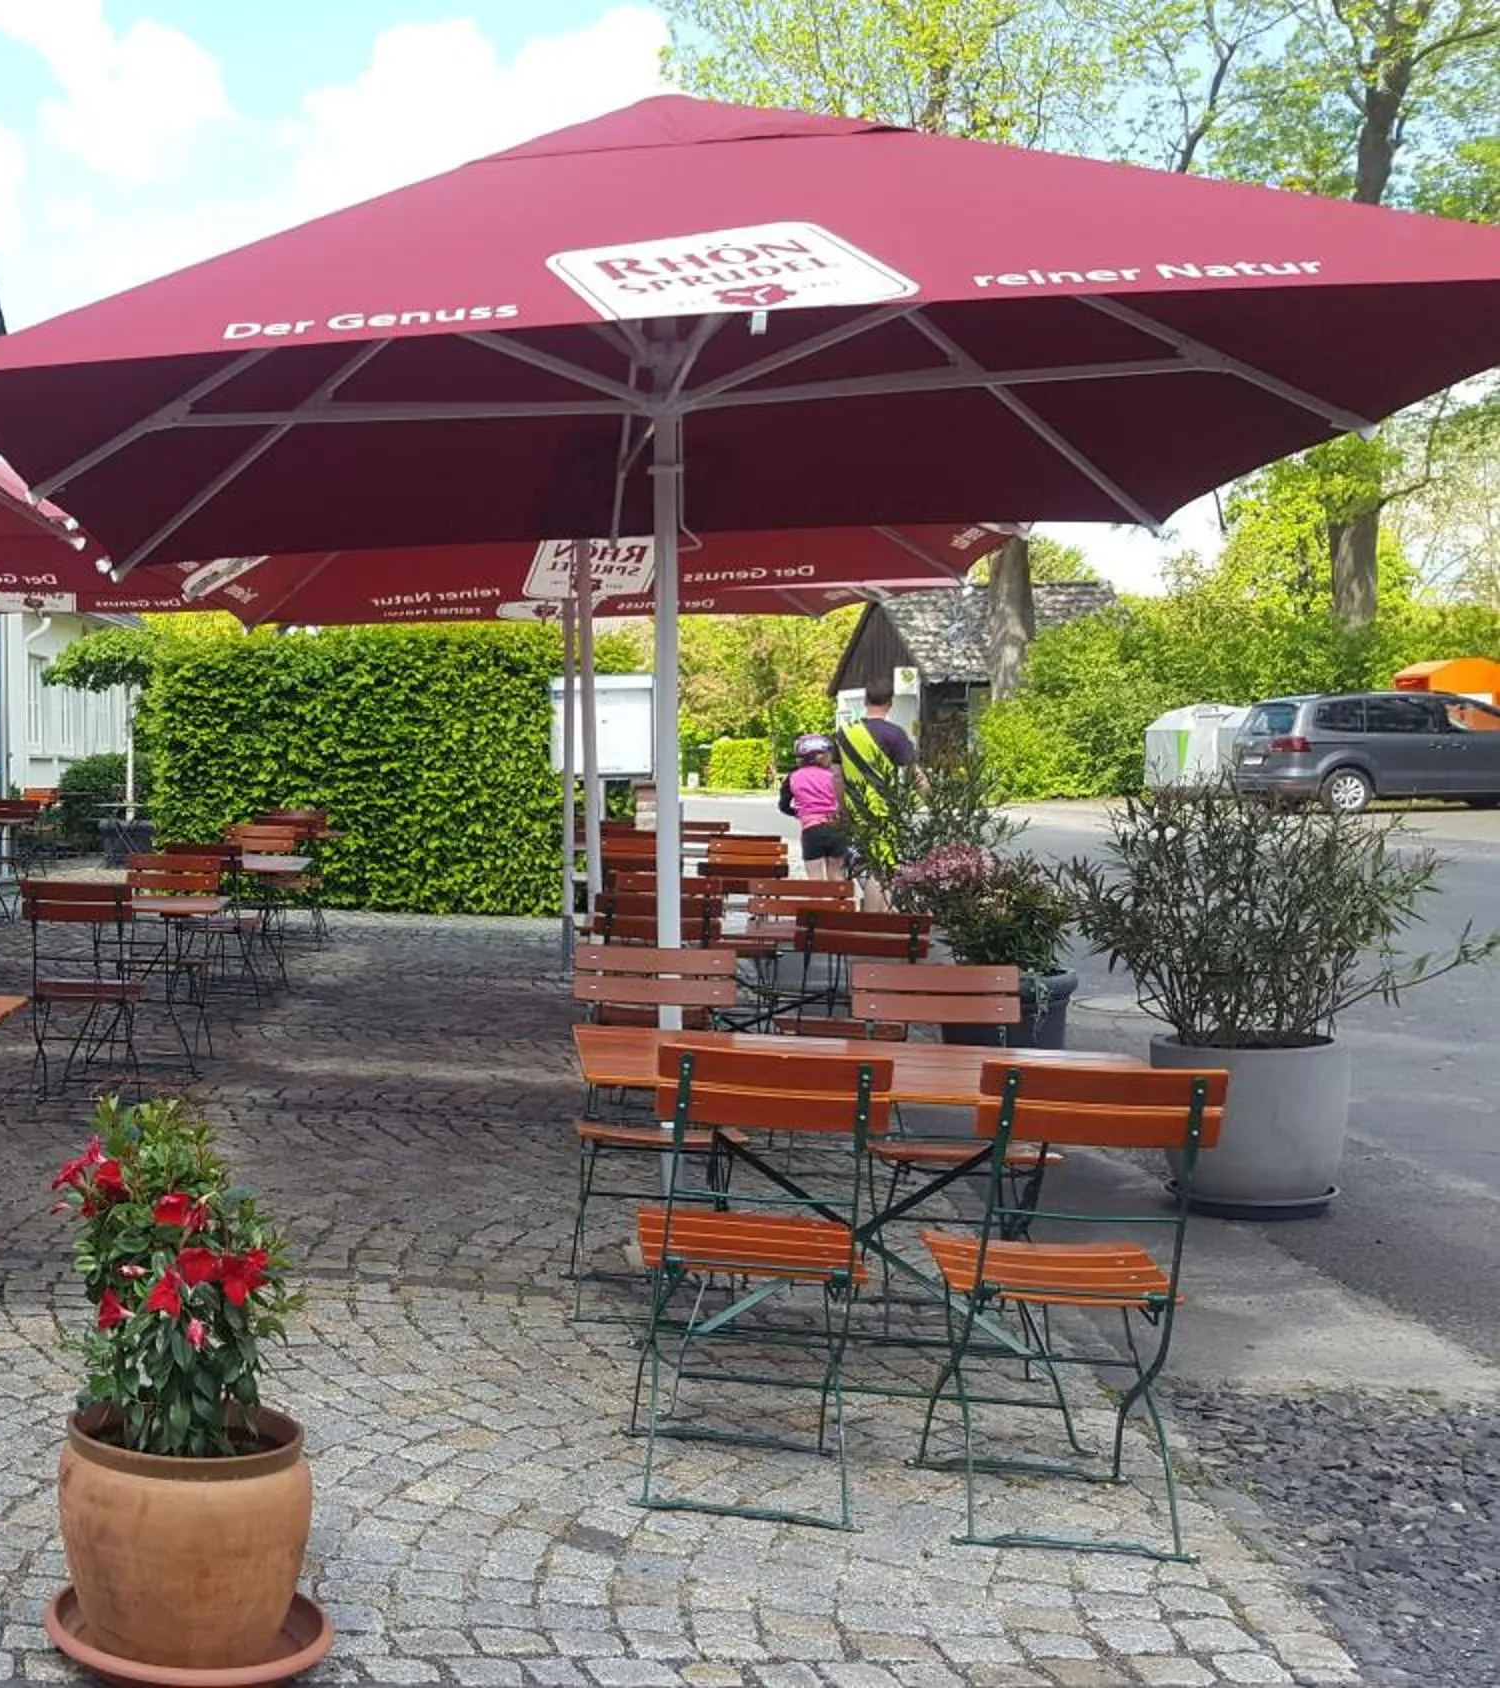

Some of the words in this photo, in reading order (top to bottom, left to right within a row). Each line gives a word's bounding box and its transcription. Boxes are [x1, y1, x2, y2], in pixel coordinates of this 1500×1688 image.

[594, 239, 814, 281] RHÖN
[618, 256, 837, 295] SPRUDEL
[973, 266, 1141, 288] reiner
[1155, 260, 1322, 280] Natur
[222, 319, 315, 340] Der
[327, 304, 519, 330] Genuss
